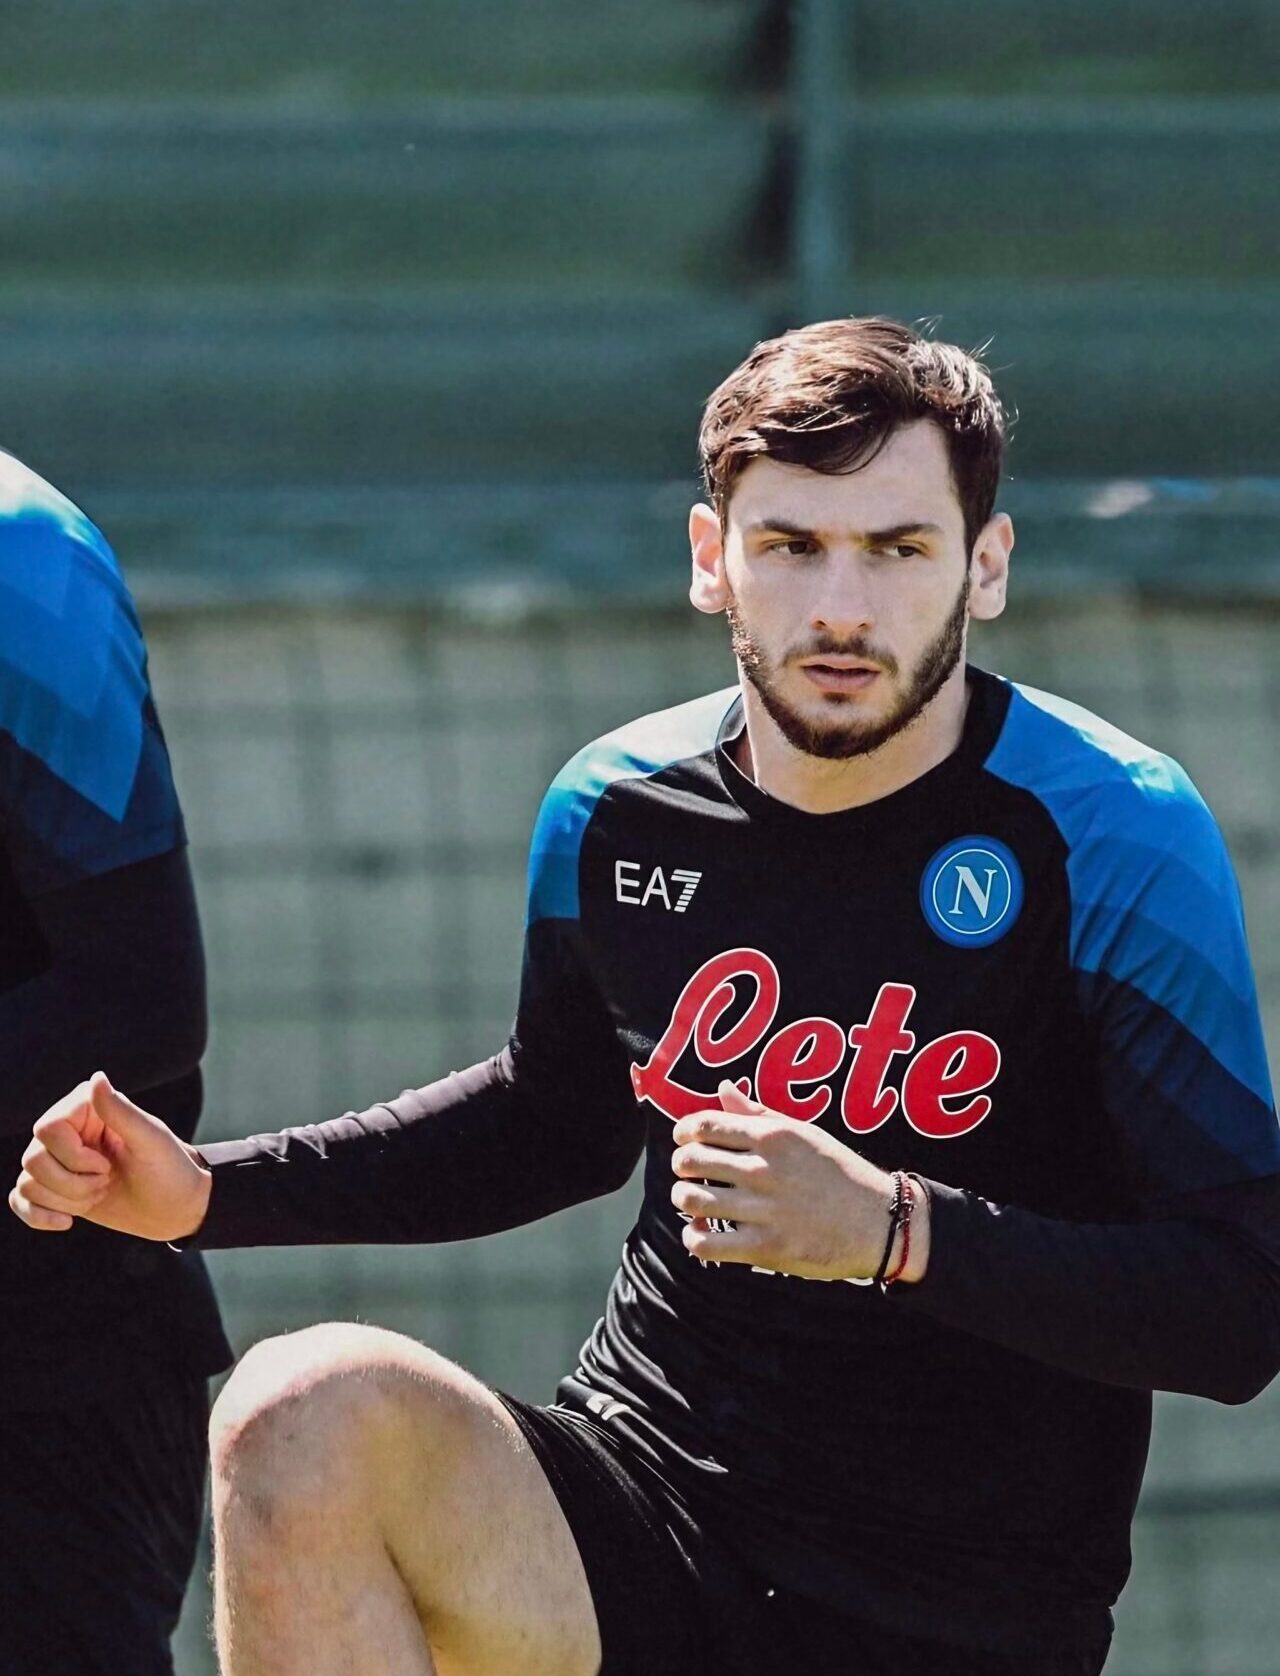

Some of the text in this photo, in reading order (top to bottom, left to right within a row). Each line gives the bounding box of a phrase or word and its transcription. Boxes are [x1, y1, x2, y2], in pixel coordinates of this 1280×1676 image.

[615, 860, 703, 913] EA7
[948, 865, 998, 919] N
[630, 947, 1001, 1138] Lete
